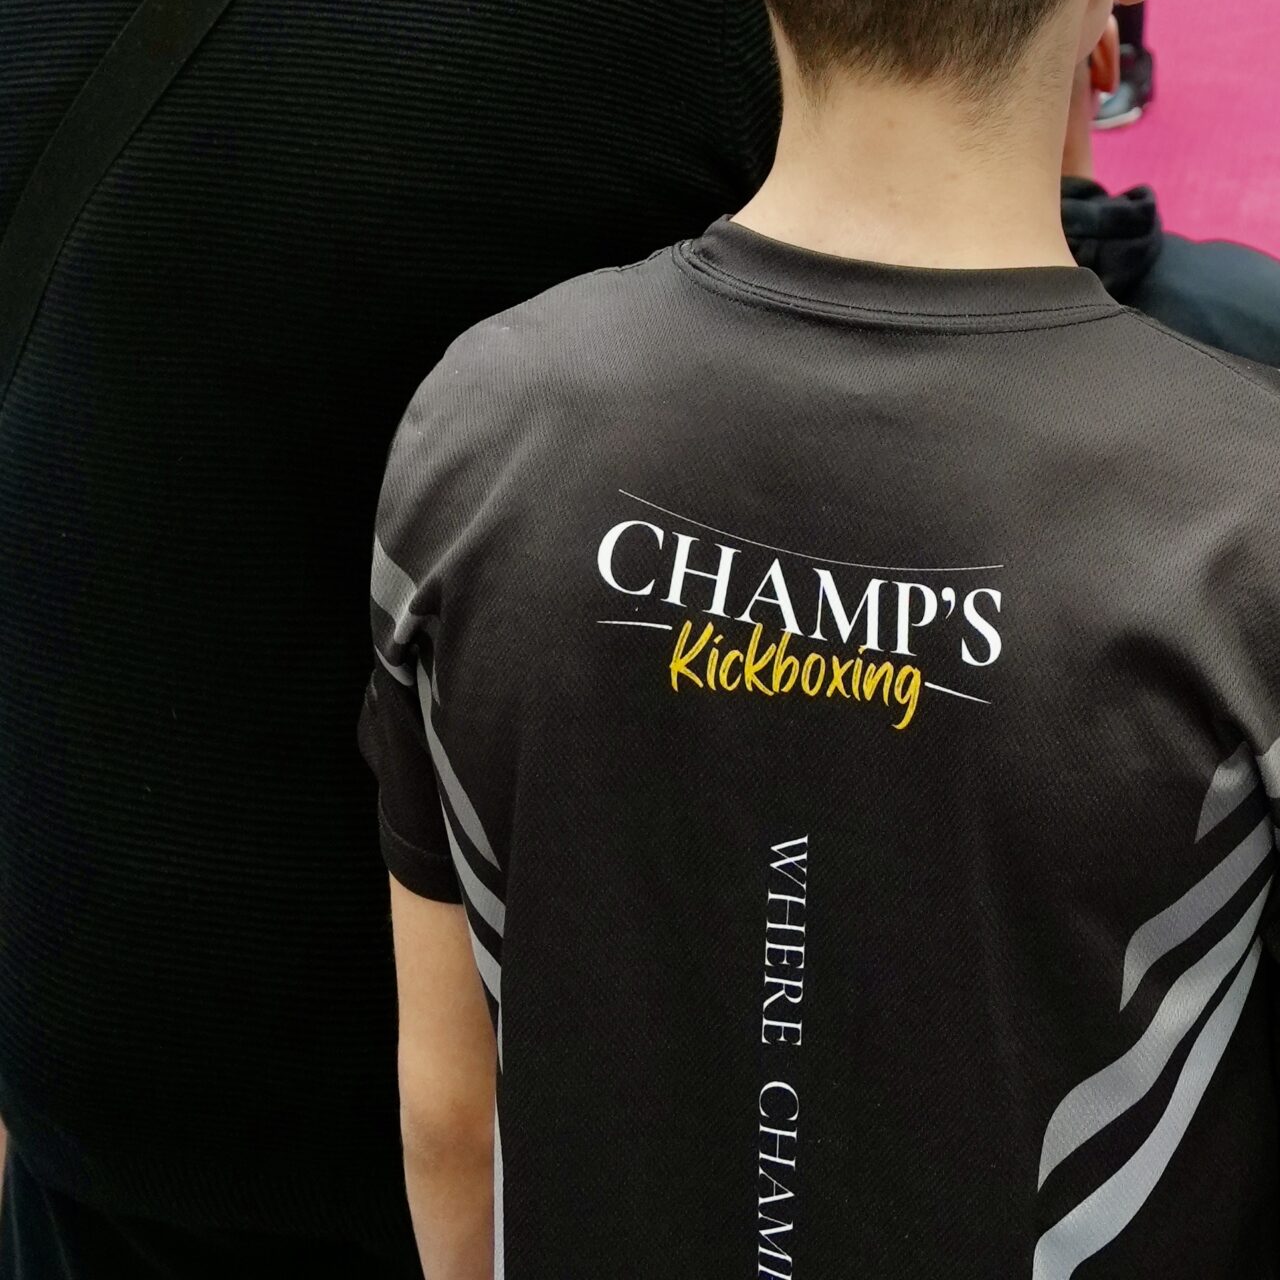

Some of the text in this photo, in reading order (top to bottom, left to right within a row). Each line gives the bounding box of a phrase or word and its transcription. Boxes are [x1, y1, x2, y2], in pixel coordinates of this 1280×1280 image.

[596, 519, 1003, 668] CHAMP'S
[669, 620, 922, 731] Kickboxing
[760, 834, 809, 1046] WHERE
